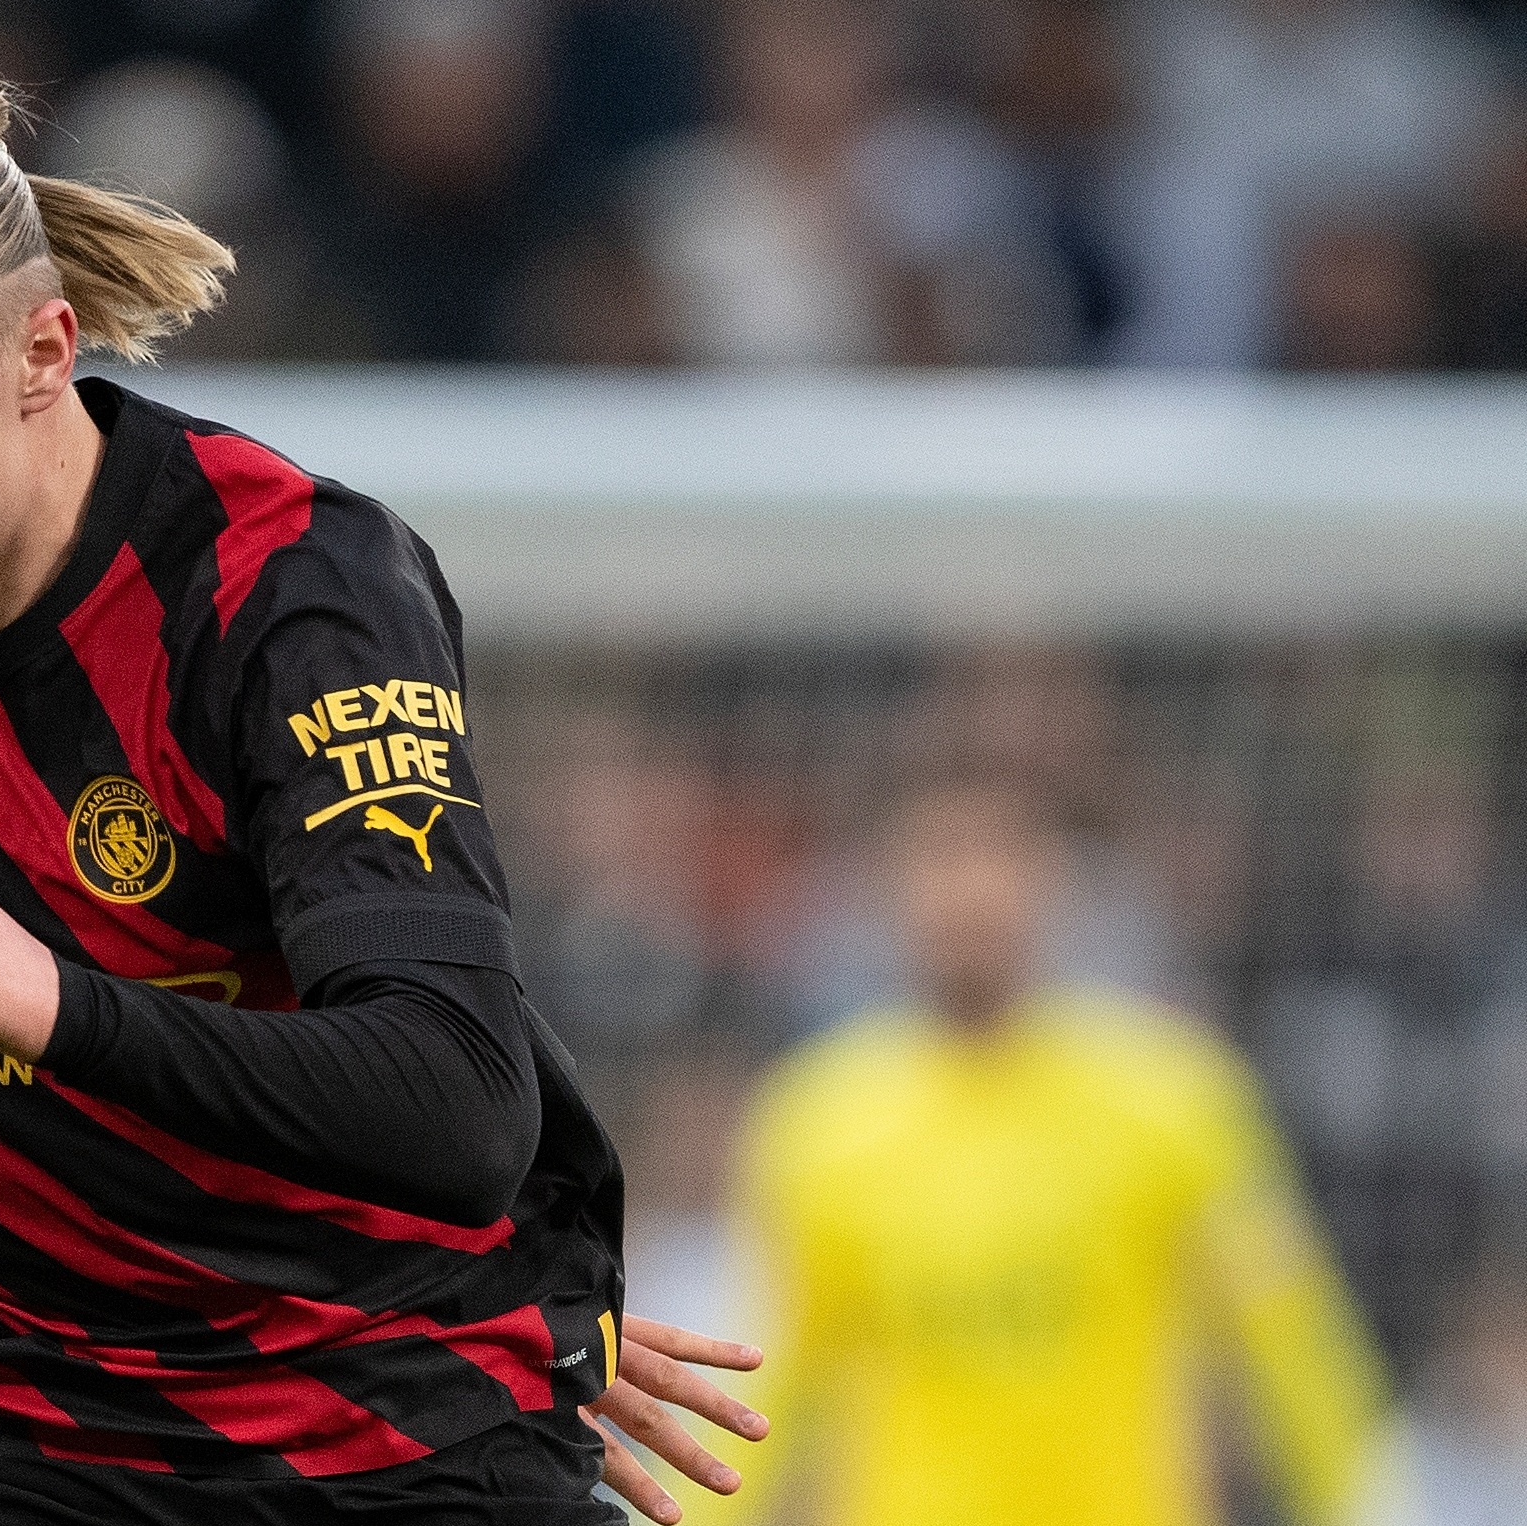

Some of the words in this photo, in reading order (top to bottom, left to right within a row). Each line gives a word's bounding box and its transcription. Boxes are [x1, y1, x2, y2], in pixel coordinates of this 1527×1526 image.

[288, 679, 465, 757] NEXEN
[325, 732, 451, 791] TIRE
[80, 783, 160, 825] MANCHESTER
[112, 880, 145, 894] CITY
